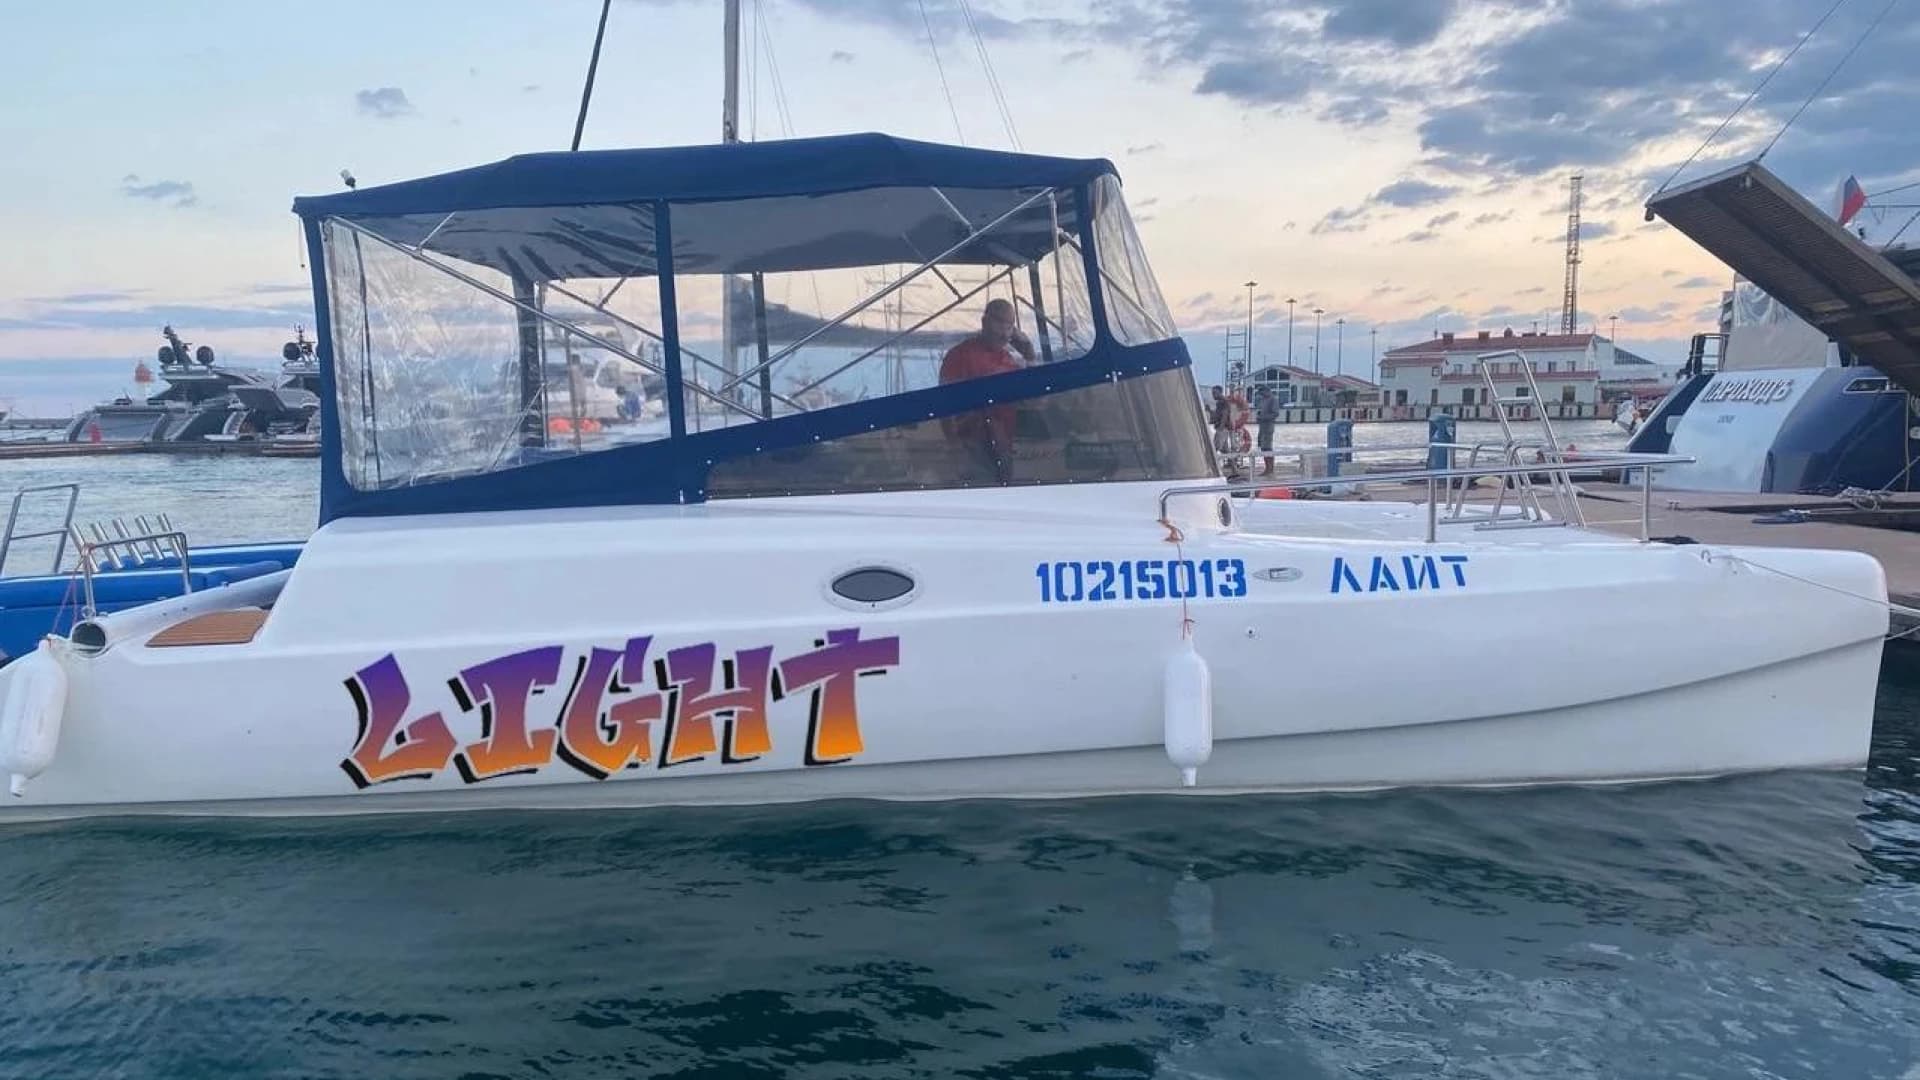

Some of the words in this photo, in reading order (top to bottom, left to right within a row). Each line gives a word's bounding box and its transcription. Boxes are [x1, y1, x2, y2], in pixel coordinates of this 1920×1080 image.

[1036, 558, 1247, 602] 10215013
[1331, 554, 1468, 593] ЛАЙТ
[340, 627, 899, 789] LIGHT
